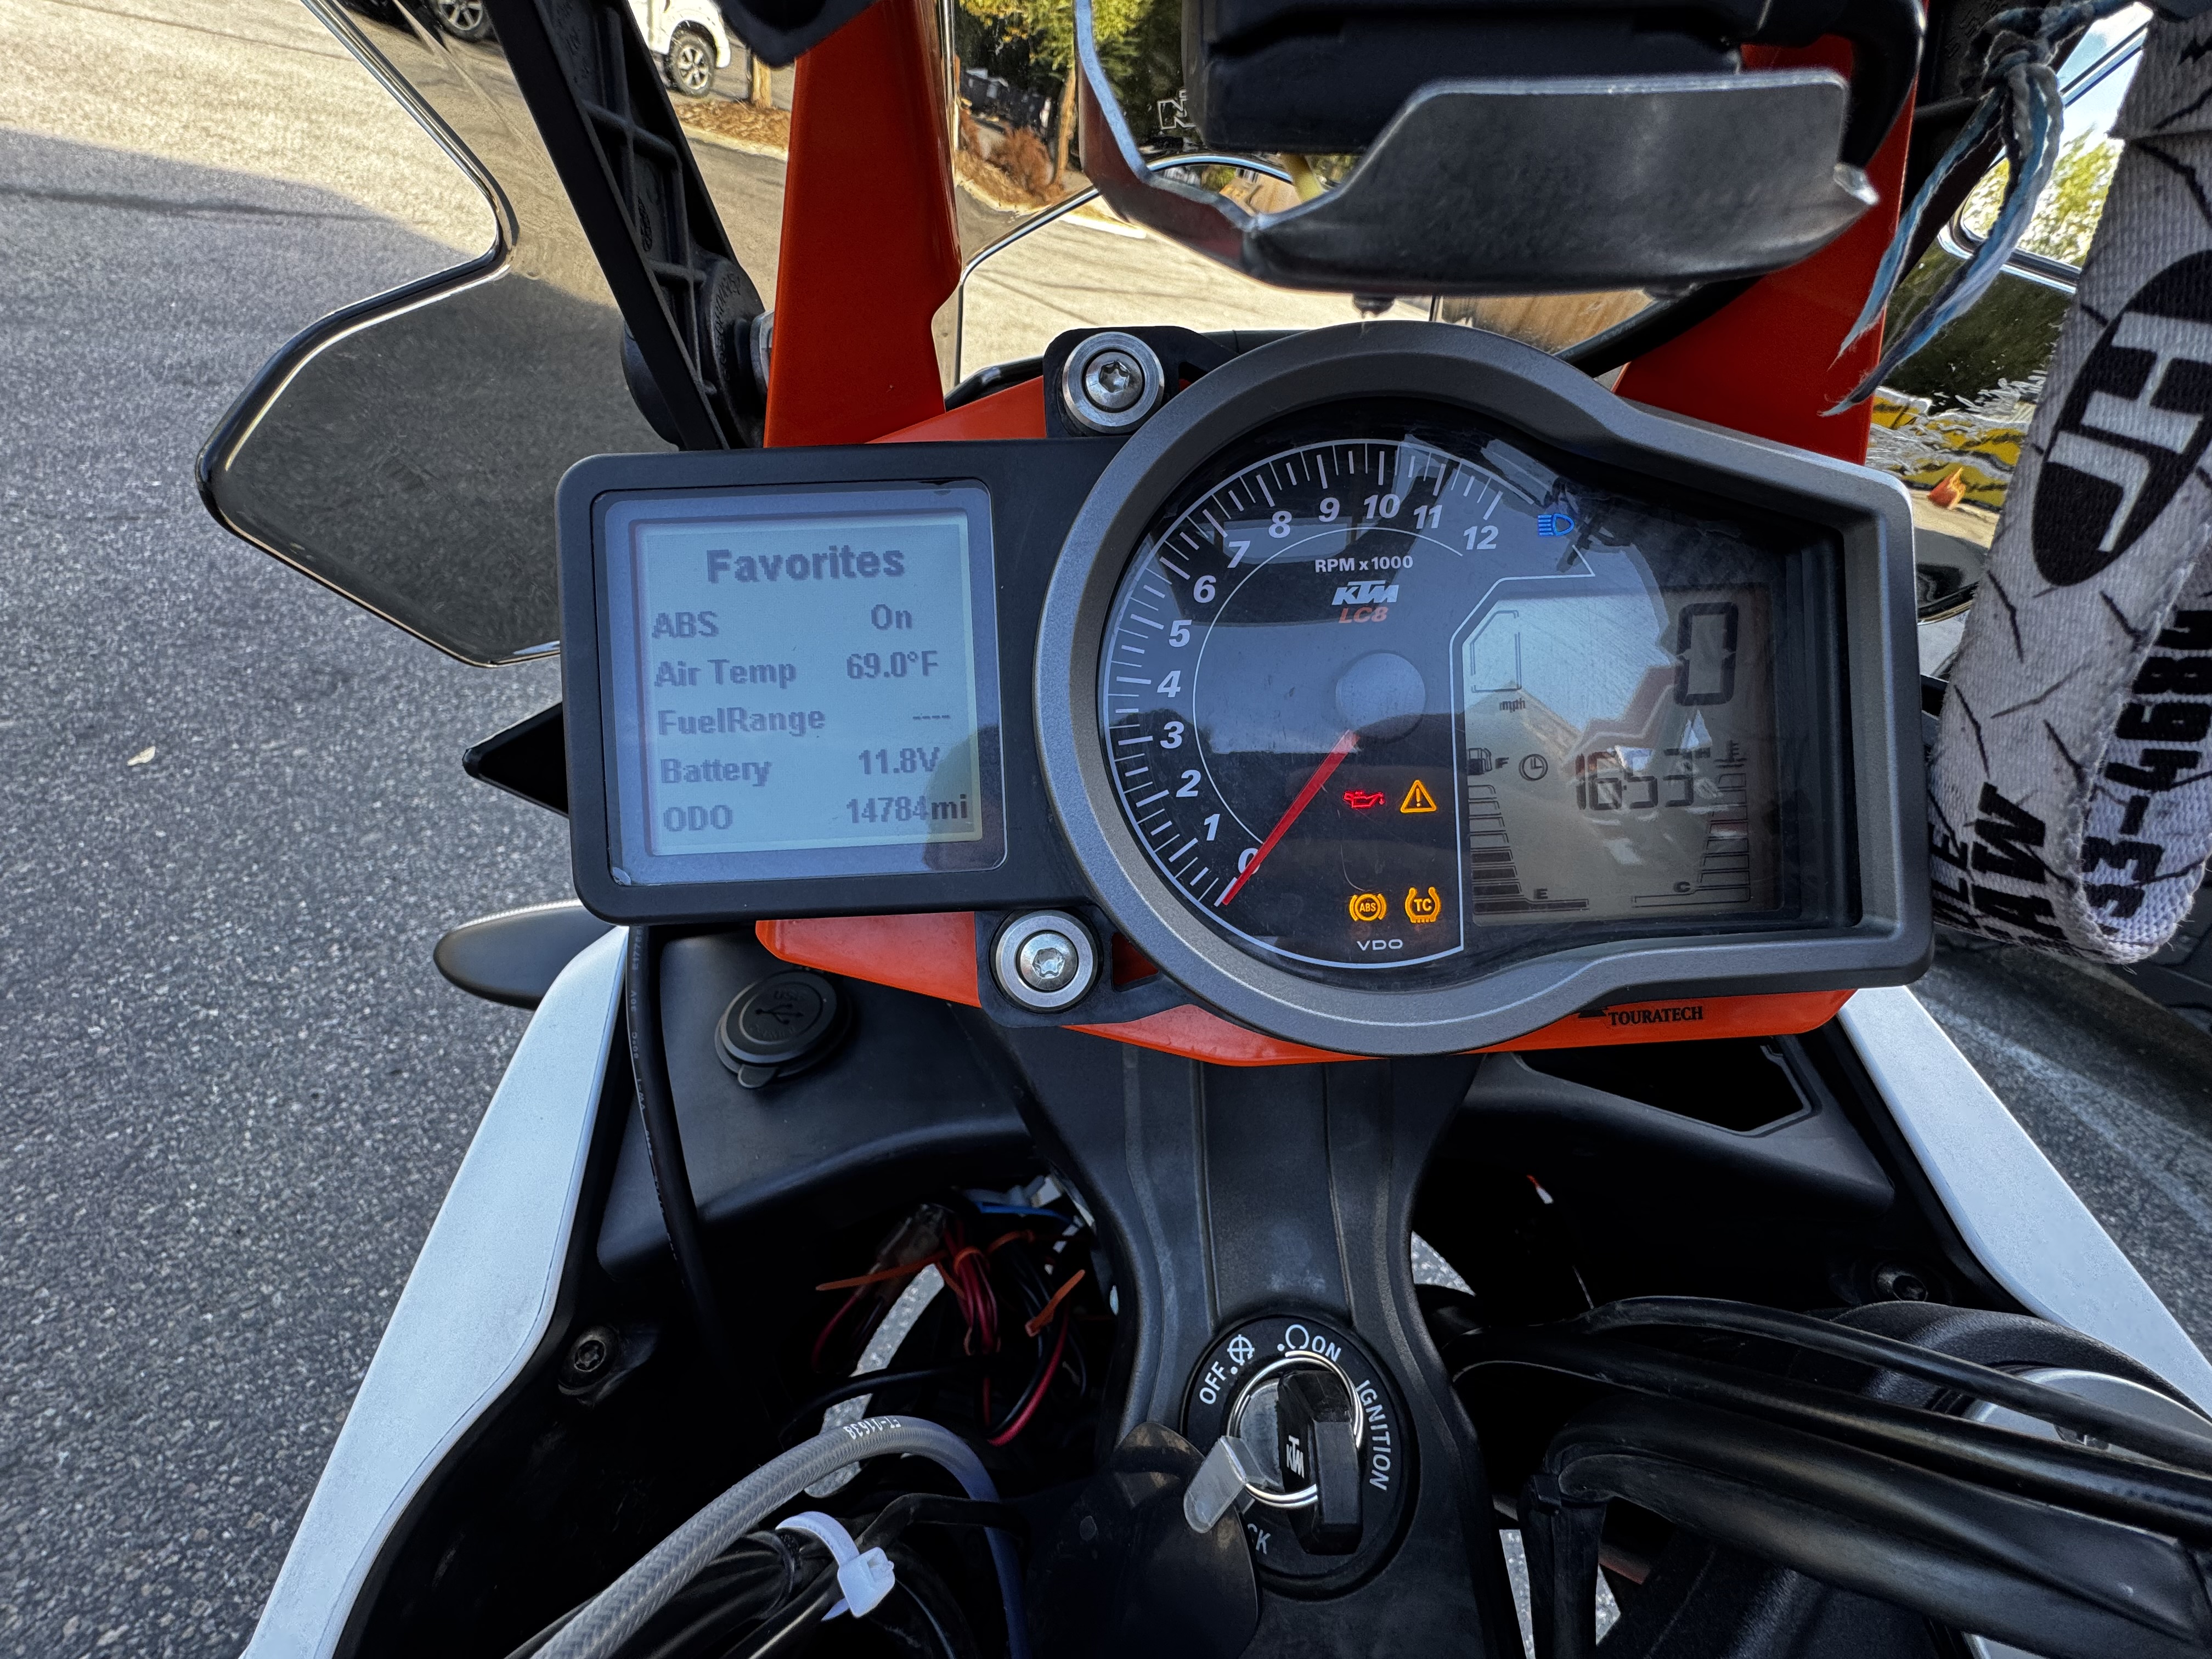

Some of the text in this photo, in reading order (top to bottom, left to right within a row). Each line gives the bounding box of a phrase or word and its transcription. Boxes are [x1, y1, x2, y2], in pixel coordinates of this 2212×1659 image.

[1318, 498, 1340, 522] 9
[1364, 494, 1400, 519] 10
[1413, 505, 1442, 529] 11
[1268, 511, 1292, 539] 8
[1463, 525, 1499, 550] 12
[706, 545, 905, 584] Favorites
[1227, 540, 1250, 568] 7
[1315, 558, 1355, 573] RPM
[1193, 575, 1216, 603] 6
[1331, 579, 1400, 606] KTM
[652, 605, 913, 639] ABS On
[1338, 606, 1389, 624] LC8
[1168, 620, 1193, 647] 5
[1675, 602, 1739, 707] 0
[654, 650, 939, 689] Air Temp 69.0°F
[1156, 670, 1182, 698] 4
[1499, 698, 1526, 713] mph
[658, 707, 826, 737] FuelRange
[1160, 721, 1184, 749] 3
[661, 746, 941, 787] Battery 11.8V
[1495, 757, 1509, 769] F
[1176, 770, 1201, 798] 2
[664, 804, 733, 832] ODO
[1204, 813, 1221, 841] 1
[1238, 848, 1261, 874] 0
[1533, 888, 1549, 900] E
[1673, 881, 1691, 893] C
[1359, 902, 1376, 913] ABS
[1413, 898, 1432, 912] TC
[1357, 939, 1403, 951] VDO
[1608, 1006, 1703, 1026] TOURATECH
[1311, 1335, 1342, 1362] ON
[1199, 1361, 1227, 1405] OFF
[1355, 1379, 1392, 1491] IGNITION
[1286, 1435, 1305, 1479] KTM
